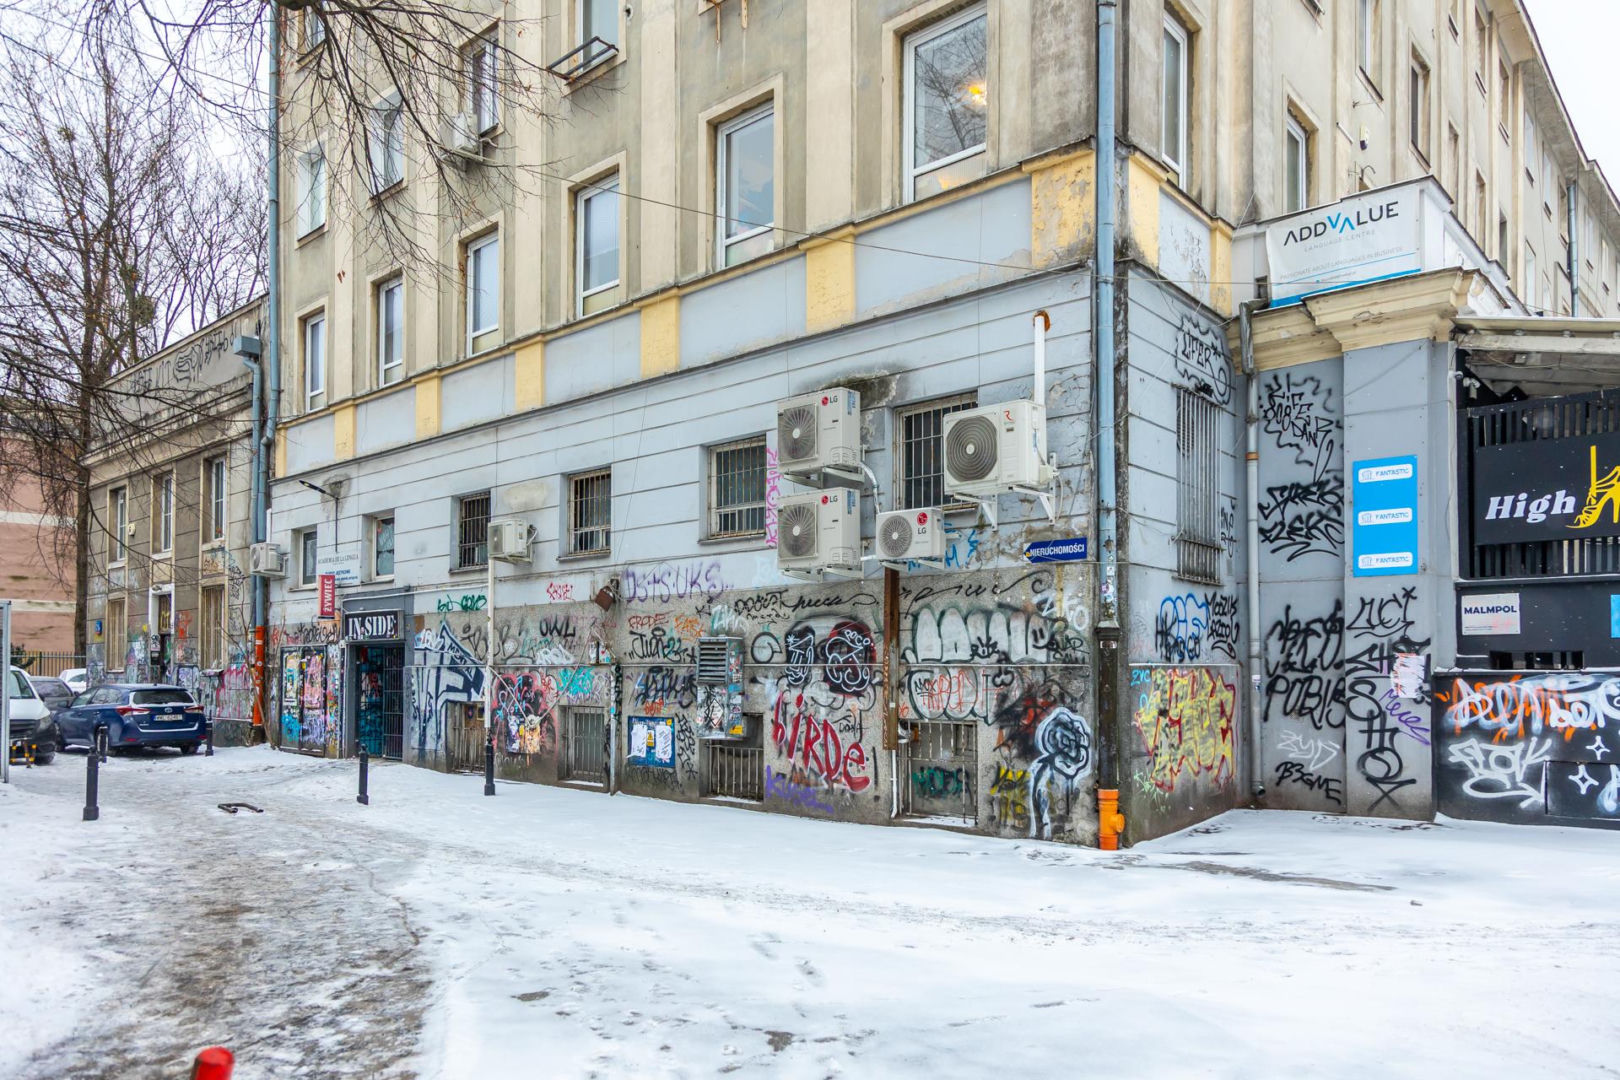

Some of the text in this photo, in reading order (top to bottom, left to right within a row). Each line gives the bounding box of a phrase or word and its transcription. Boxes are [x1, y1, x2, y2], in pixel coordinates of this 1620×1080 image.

[1346, 229, 1376, 242] CENTRE
[829, 396, 838, 404] LG
[1375, 468, 1409, 477] FANTASTIC
[829, 495, 838, 503] LG
[1485, 490, 1576, 524] High
[1375, 511, 1409, 520] FANTASTIC
[917, 527, 926, 535] LG
[1030, 543, 1085, 557] NIERUCHOMOŚCI
[1375, 555, 1409, 564] FANTASTIC
[323, 578, 333, 613] ŻYWIEC
[1463, 605, 1517, 615] MALMPOL
